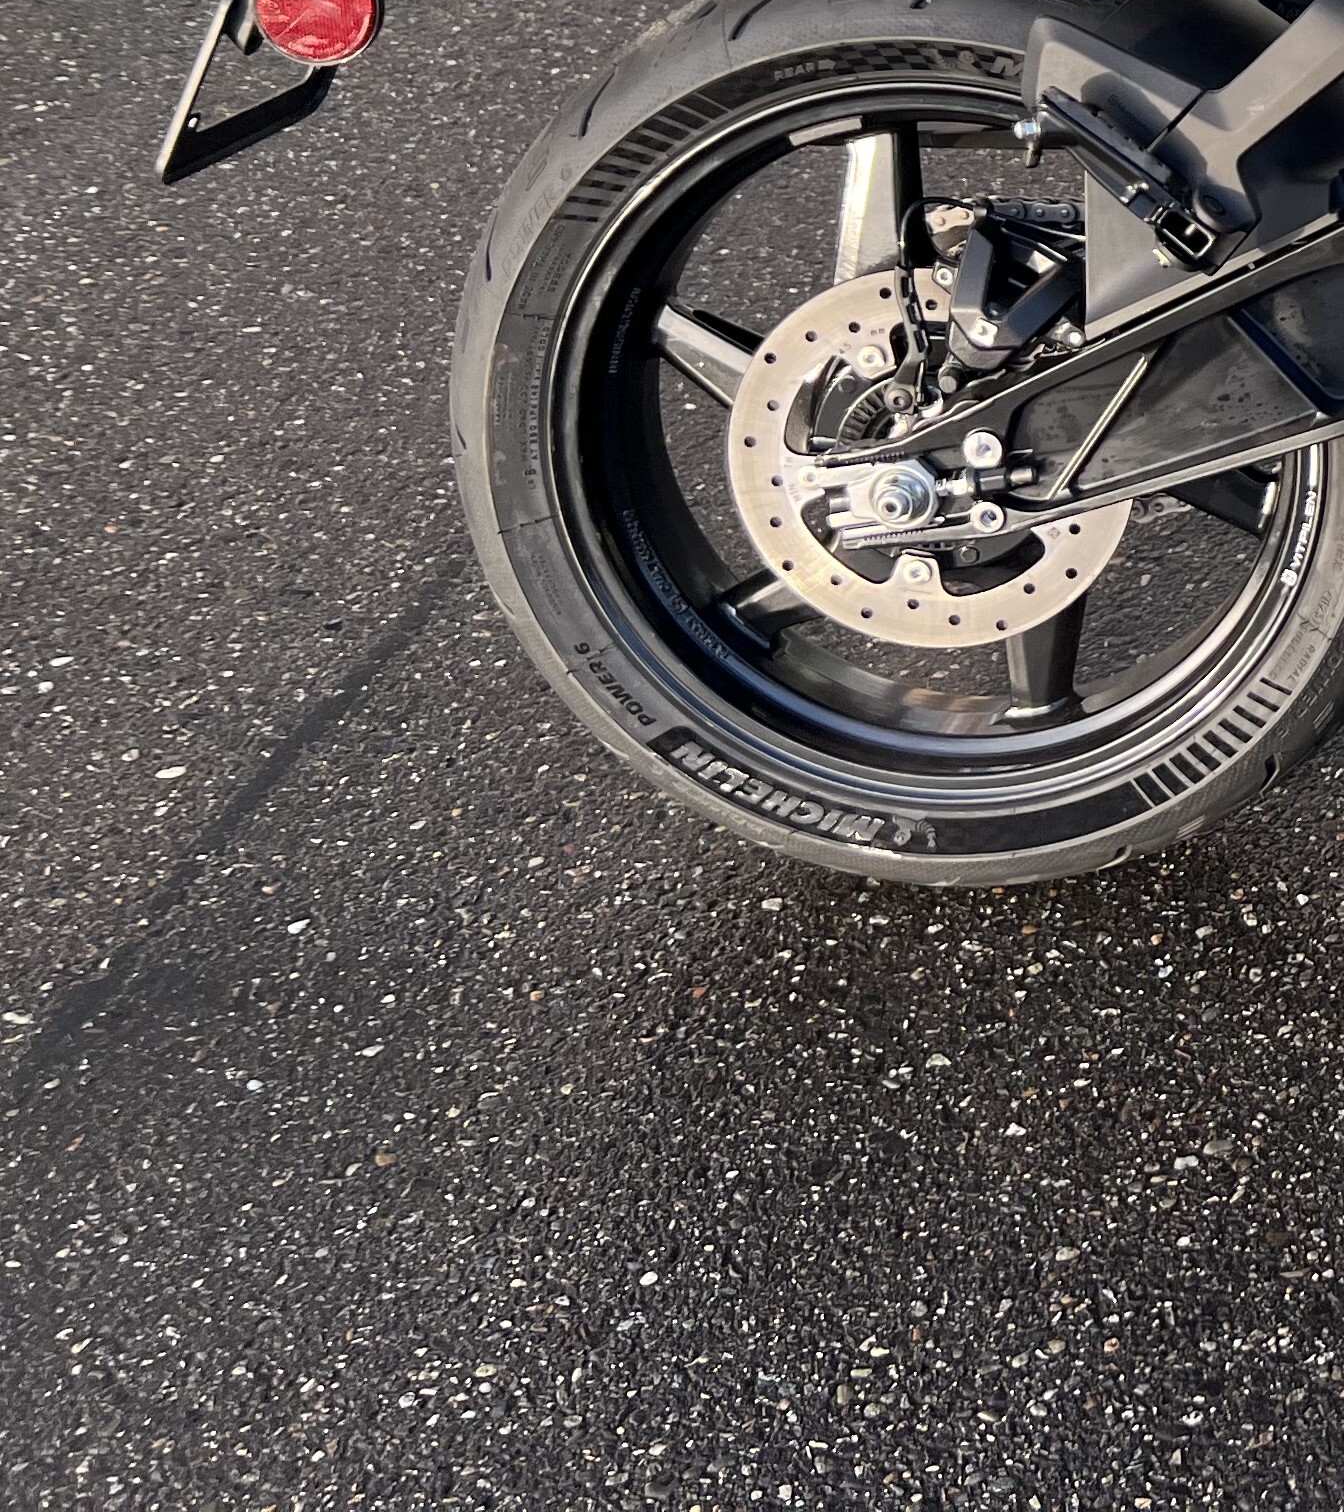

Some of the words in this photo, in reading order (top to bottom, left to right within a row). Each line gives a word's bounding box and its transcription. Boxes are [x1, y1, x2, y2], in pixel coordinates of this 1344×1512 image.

[1290, 490, 1317, 569] VITPILEN
[573, 640, 591, 656] 6
[588, 658, 659, 728] POWER
[670, 740, 886, 843] MICHELIN
